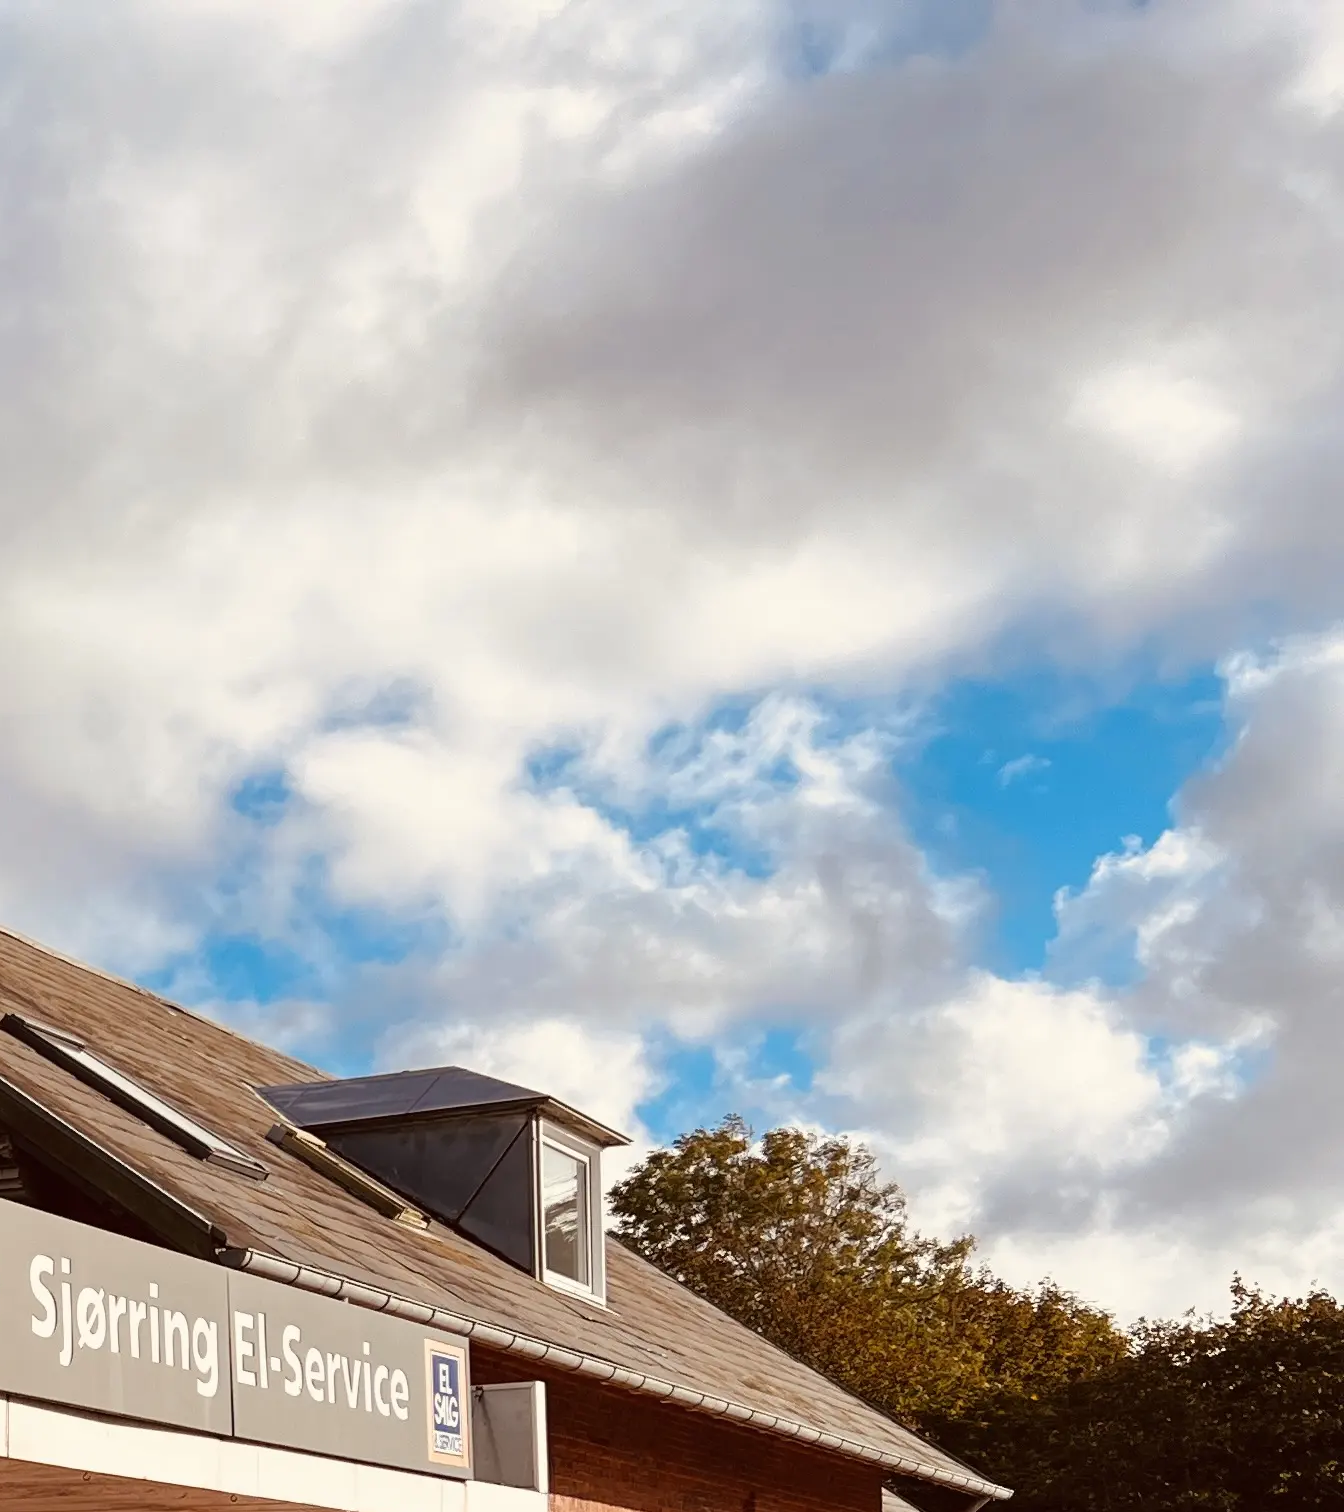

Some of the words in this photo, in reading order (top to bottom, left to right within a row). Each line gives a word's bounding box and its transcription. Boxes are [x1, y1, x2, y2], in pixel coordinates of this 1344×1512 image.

[29, 1254, 219, 1397] Sjørring
[234, 1310, 410, 1421] El-Service
[439, 1363, 452, 1394] EL
[434, 1392, 459, 1427] SALG
